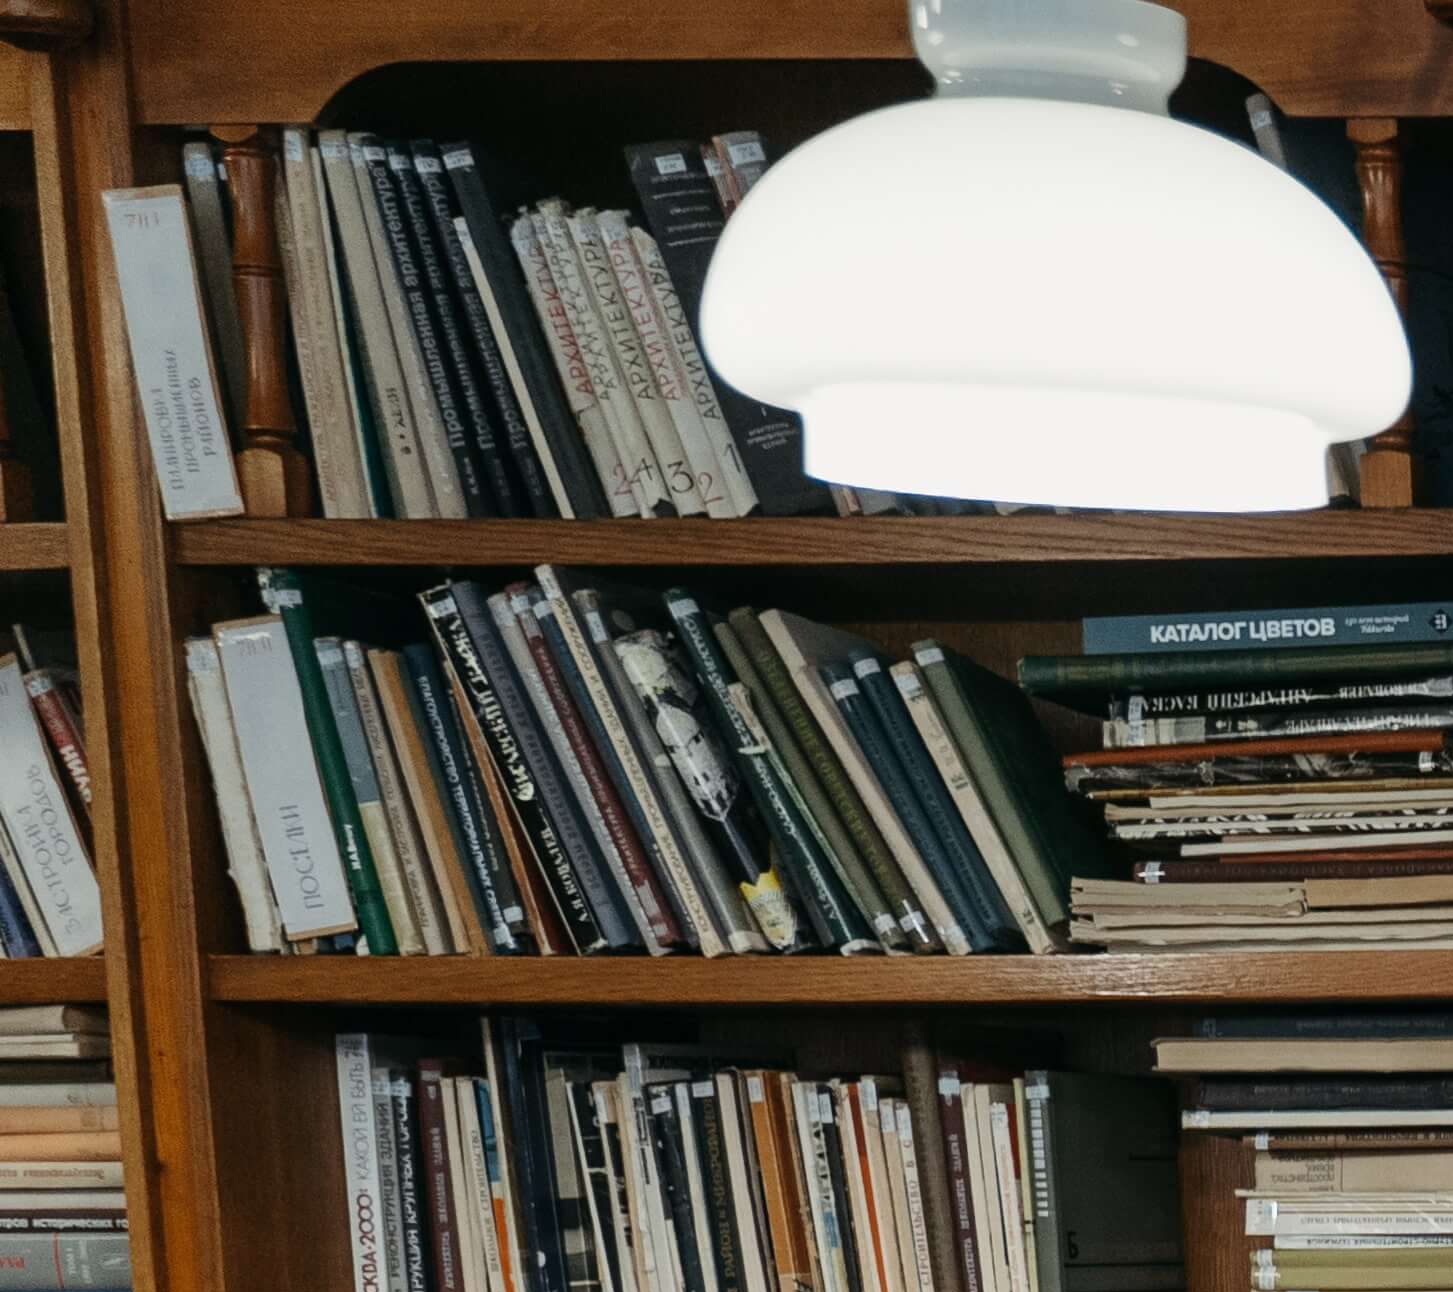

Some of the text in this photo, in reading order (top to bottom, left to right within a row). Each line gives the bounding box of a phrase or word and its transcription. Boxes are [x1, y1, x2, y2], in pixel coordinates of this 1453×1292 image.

[406, 289, 467, 449] Промышленная
[667, 460, 694, 494] 3
[1149, 620, 1247, 644] КАТАЛОГ
[1248, 617, 1337, 642] ЦВЕТОВ
